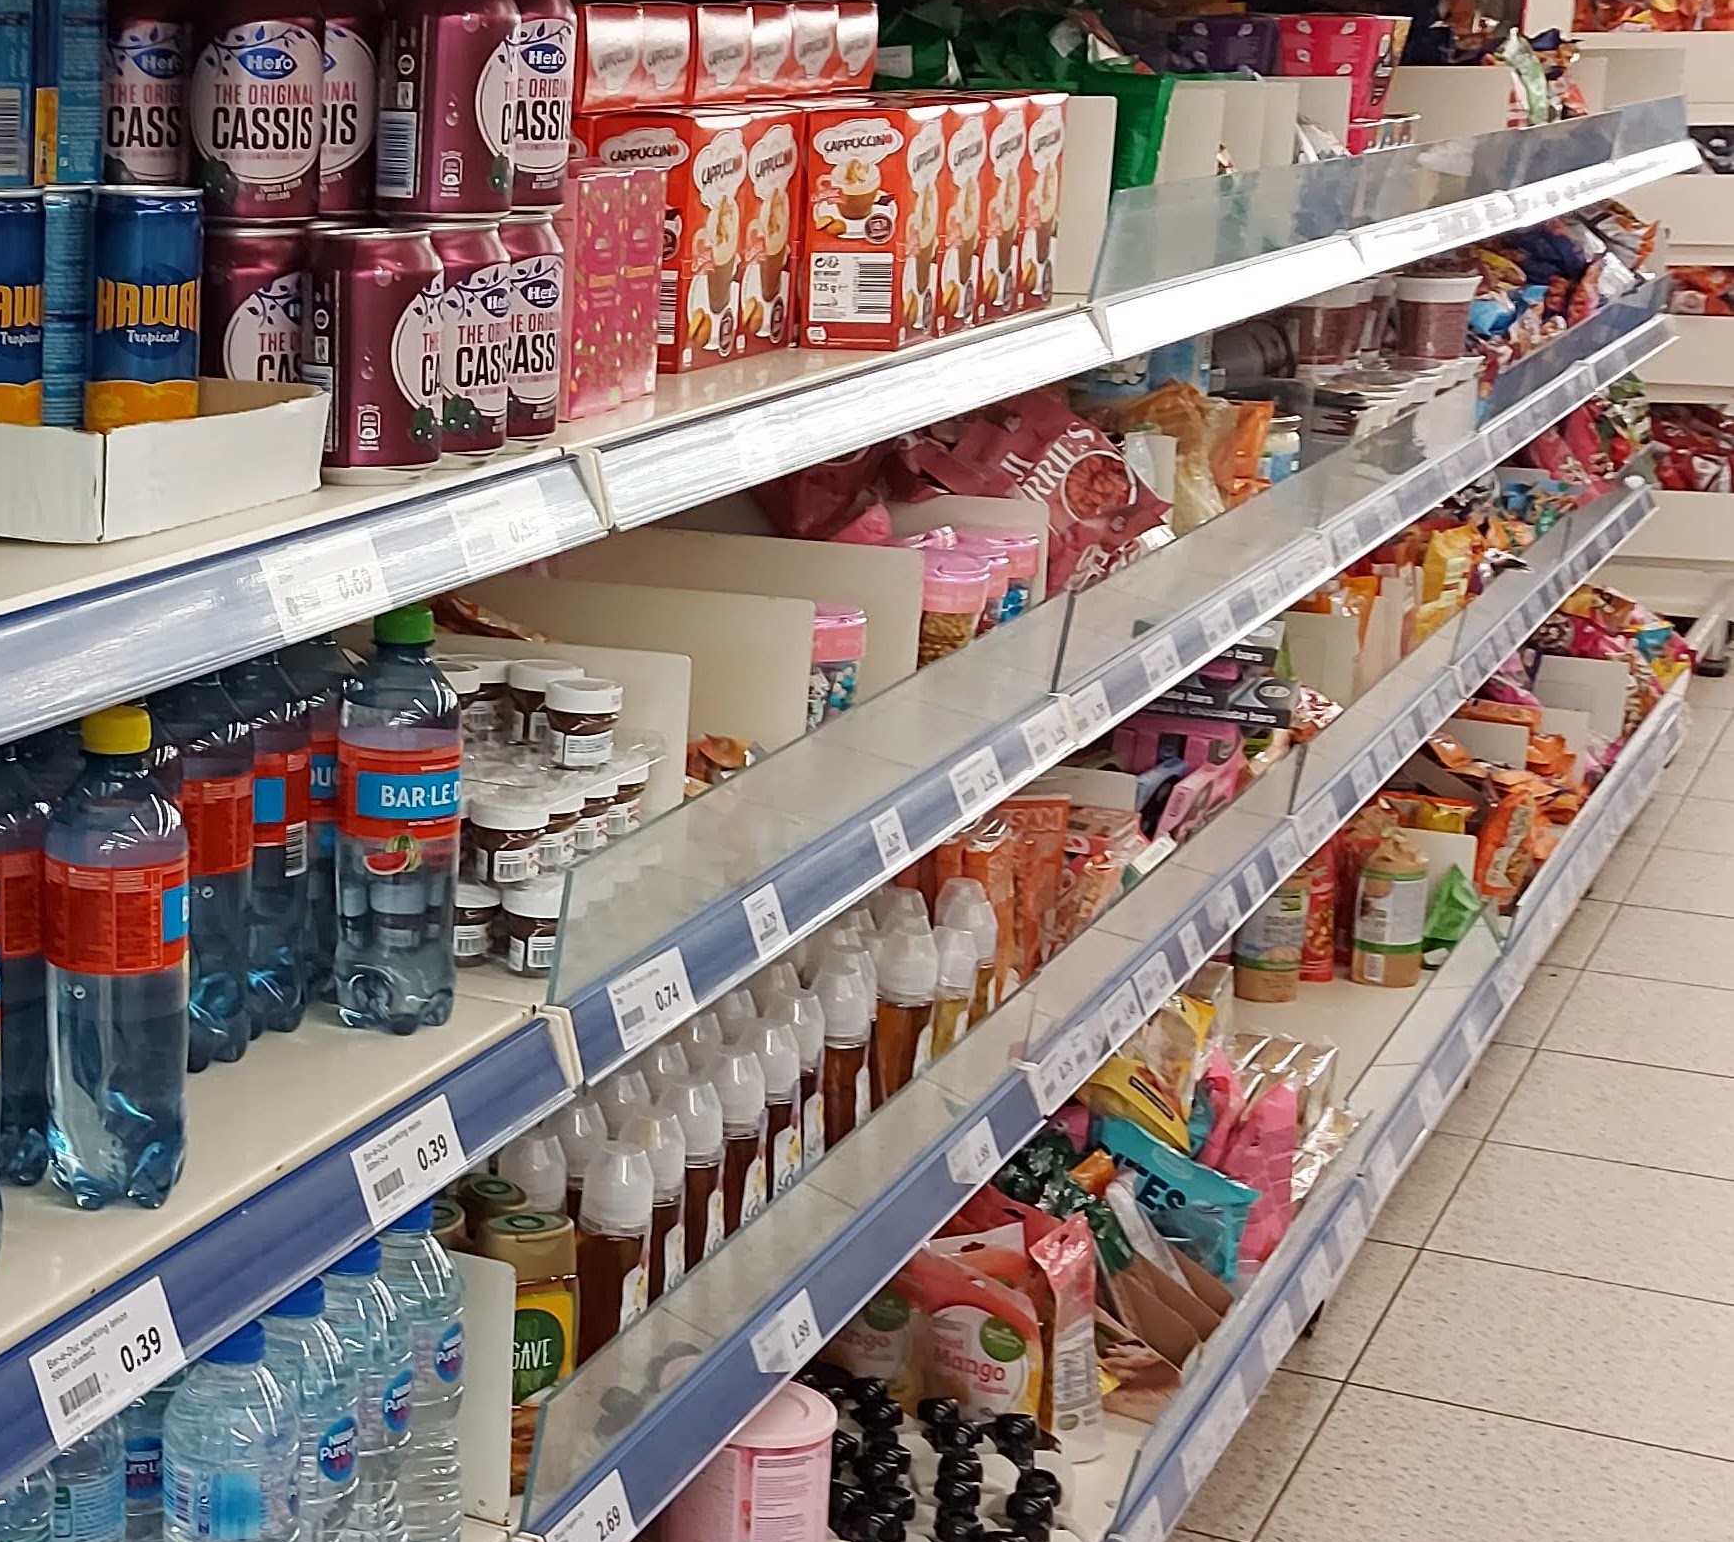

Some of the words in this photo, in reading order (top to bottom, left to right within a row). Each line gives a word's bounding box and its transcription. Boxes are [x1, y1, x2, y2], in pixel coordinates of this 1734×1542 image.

[246, 55, 293, 72] Hero
[529, 50, 566, 66] Hero
[109, 83, 140, 104] THE
[213, 83, 245, 105] THE
[248, 83, 314, 105] ORIGINAL
[212, 107, 313, 150] CASSIS
[96, 278, 199, 333] HAWA
[126, 328, 180, 346] Tropical
[259, 333, 287, 351] THE
[458, 325, 487, 343] THE
[655, 981, 680, 1012] 0.74
[417, 1133, 448, 1172] 0.39
[120, 1326, 162, 1373] 0.39
[597, 1505, 623, 1542] 2.69
